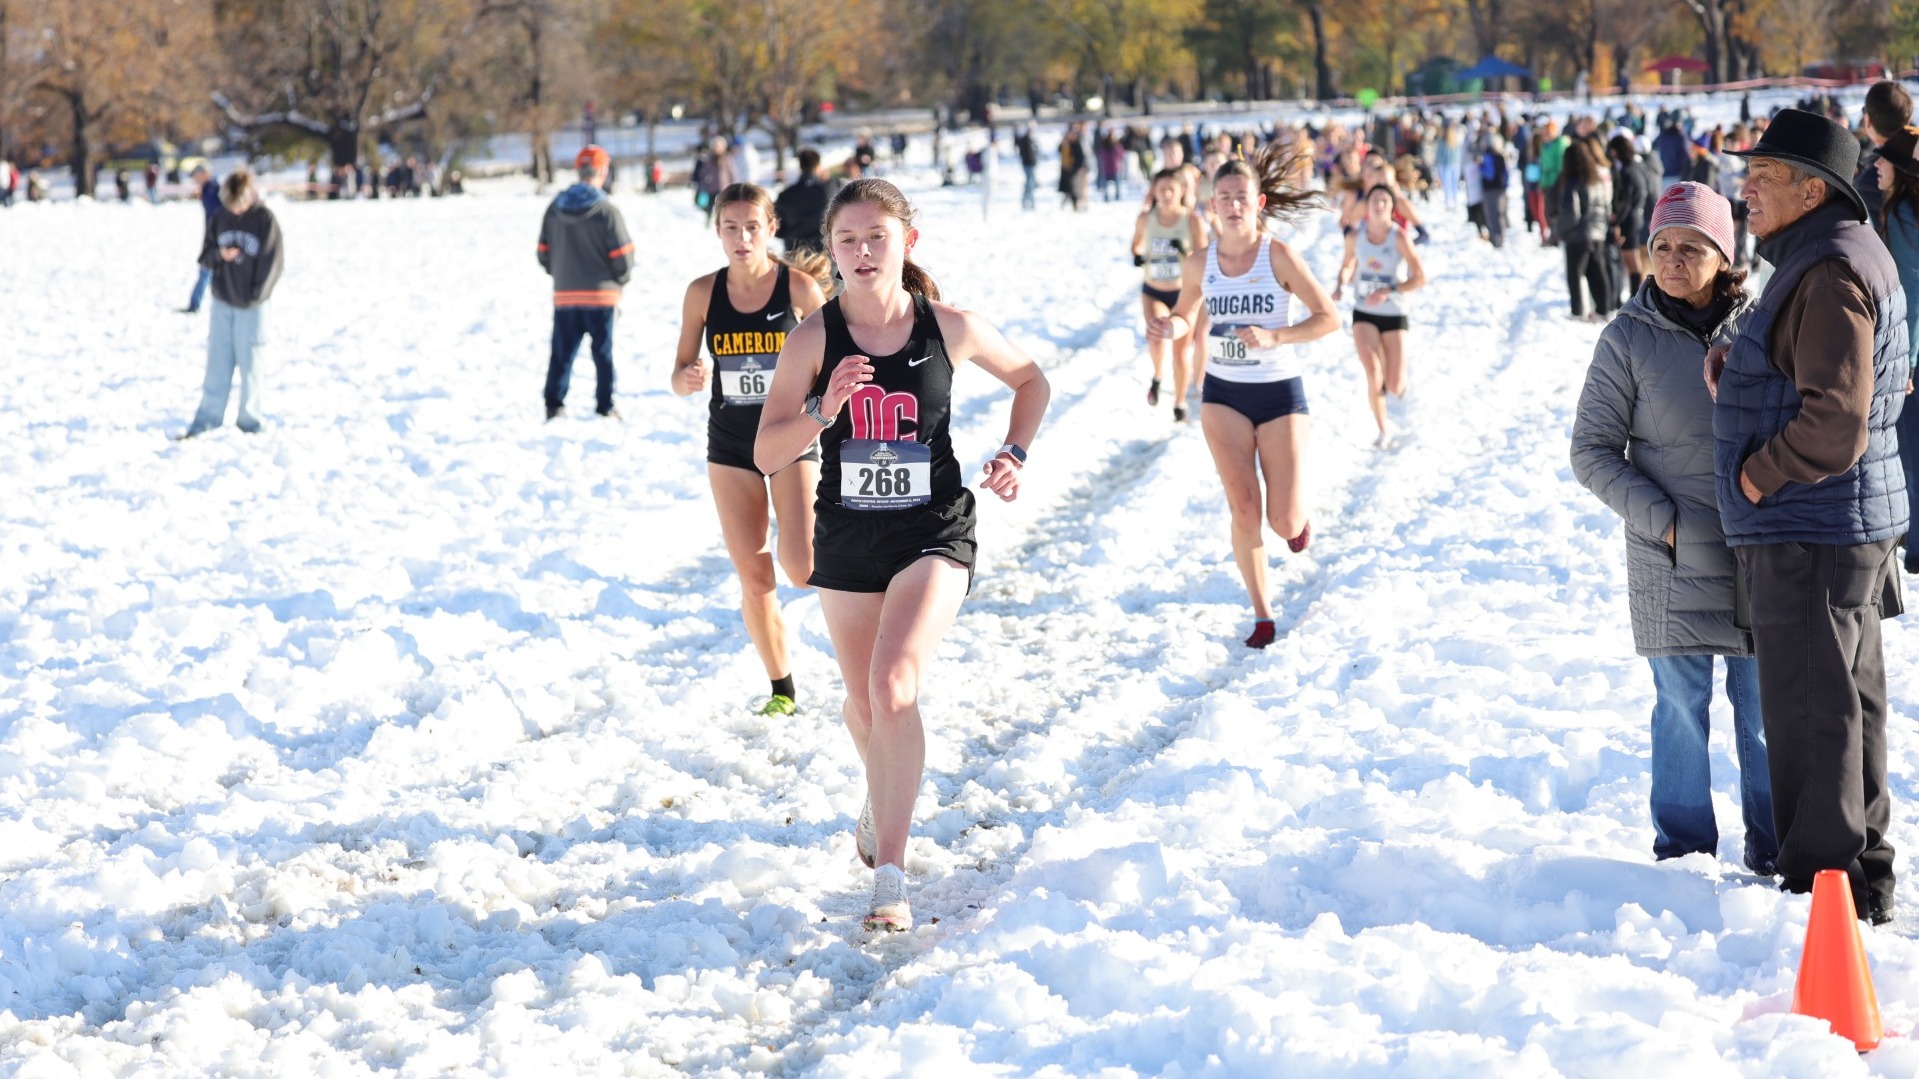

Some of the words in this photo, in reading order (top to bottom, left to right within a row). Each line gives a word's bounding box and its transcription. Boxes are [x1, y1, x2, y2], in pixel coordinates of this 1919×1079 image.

[713, 332, 786, 356] CAMERON
[1219, 341, 1247, 360] 108
[739, 374, 766, 395] 66
[858, 467, 911, 497] 268
